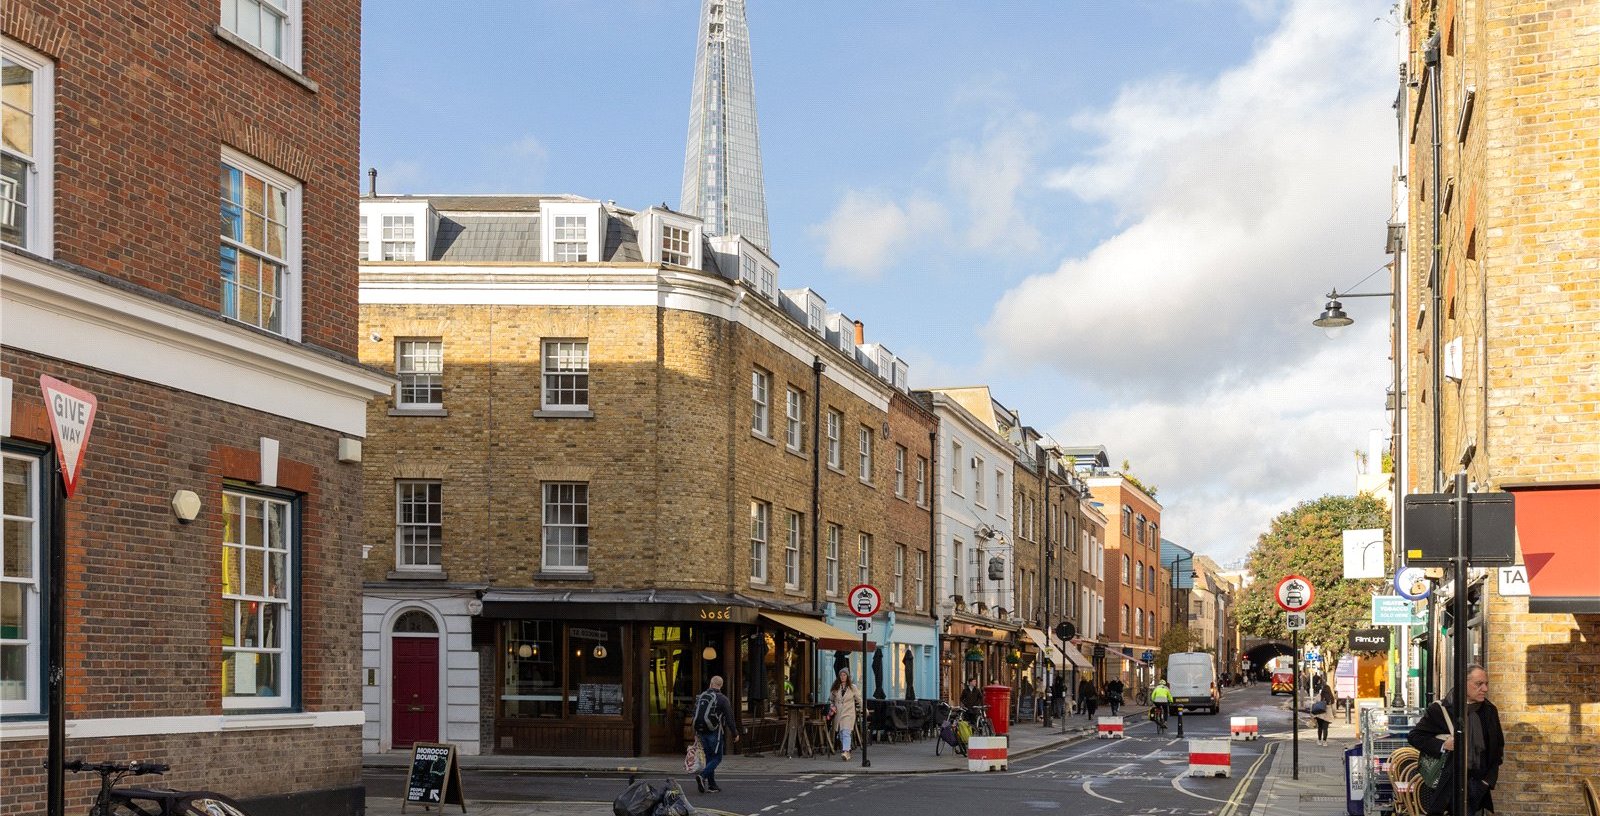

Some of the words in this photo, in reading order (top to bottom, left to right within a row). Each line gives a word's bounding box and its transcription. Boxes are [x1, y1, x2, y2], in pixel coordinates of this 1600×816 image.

[54, 394, 85, 425] GIVE
[62, 424, 81, 444] WAY
[1503, 569, 1527, 584] TA
[701, 606, 731, 619] JOSÉ
[416, 747, 449, 756] MOROCCO
